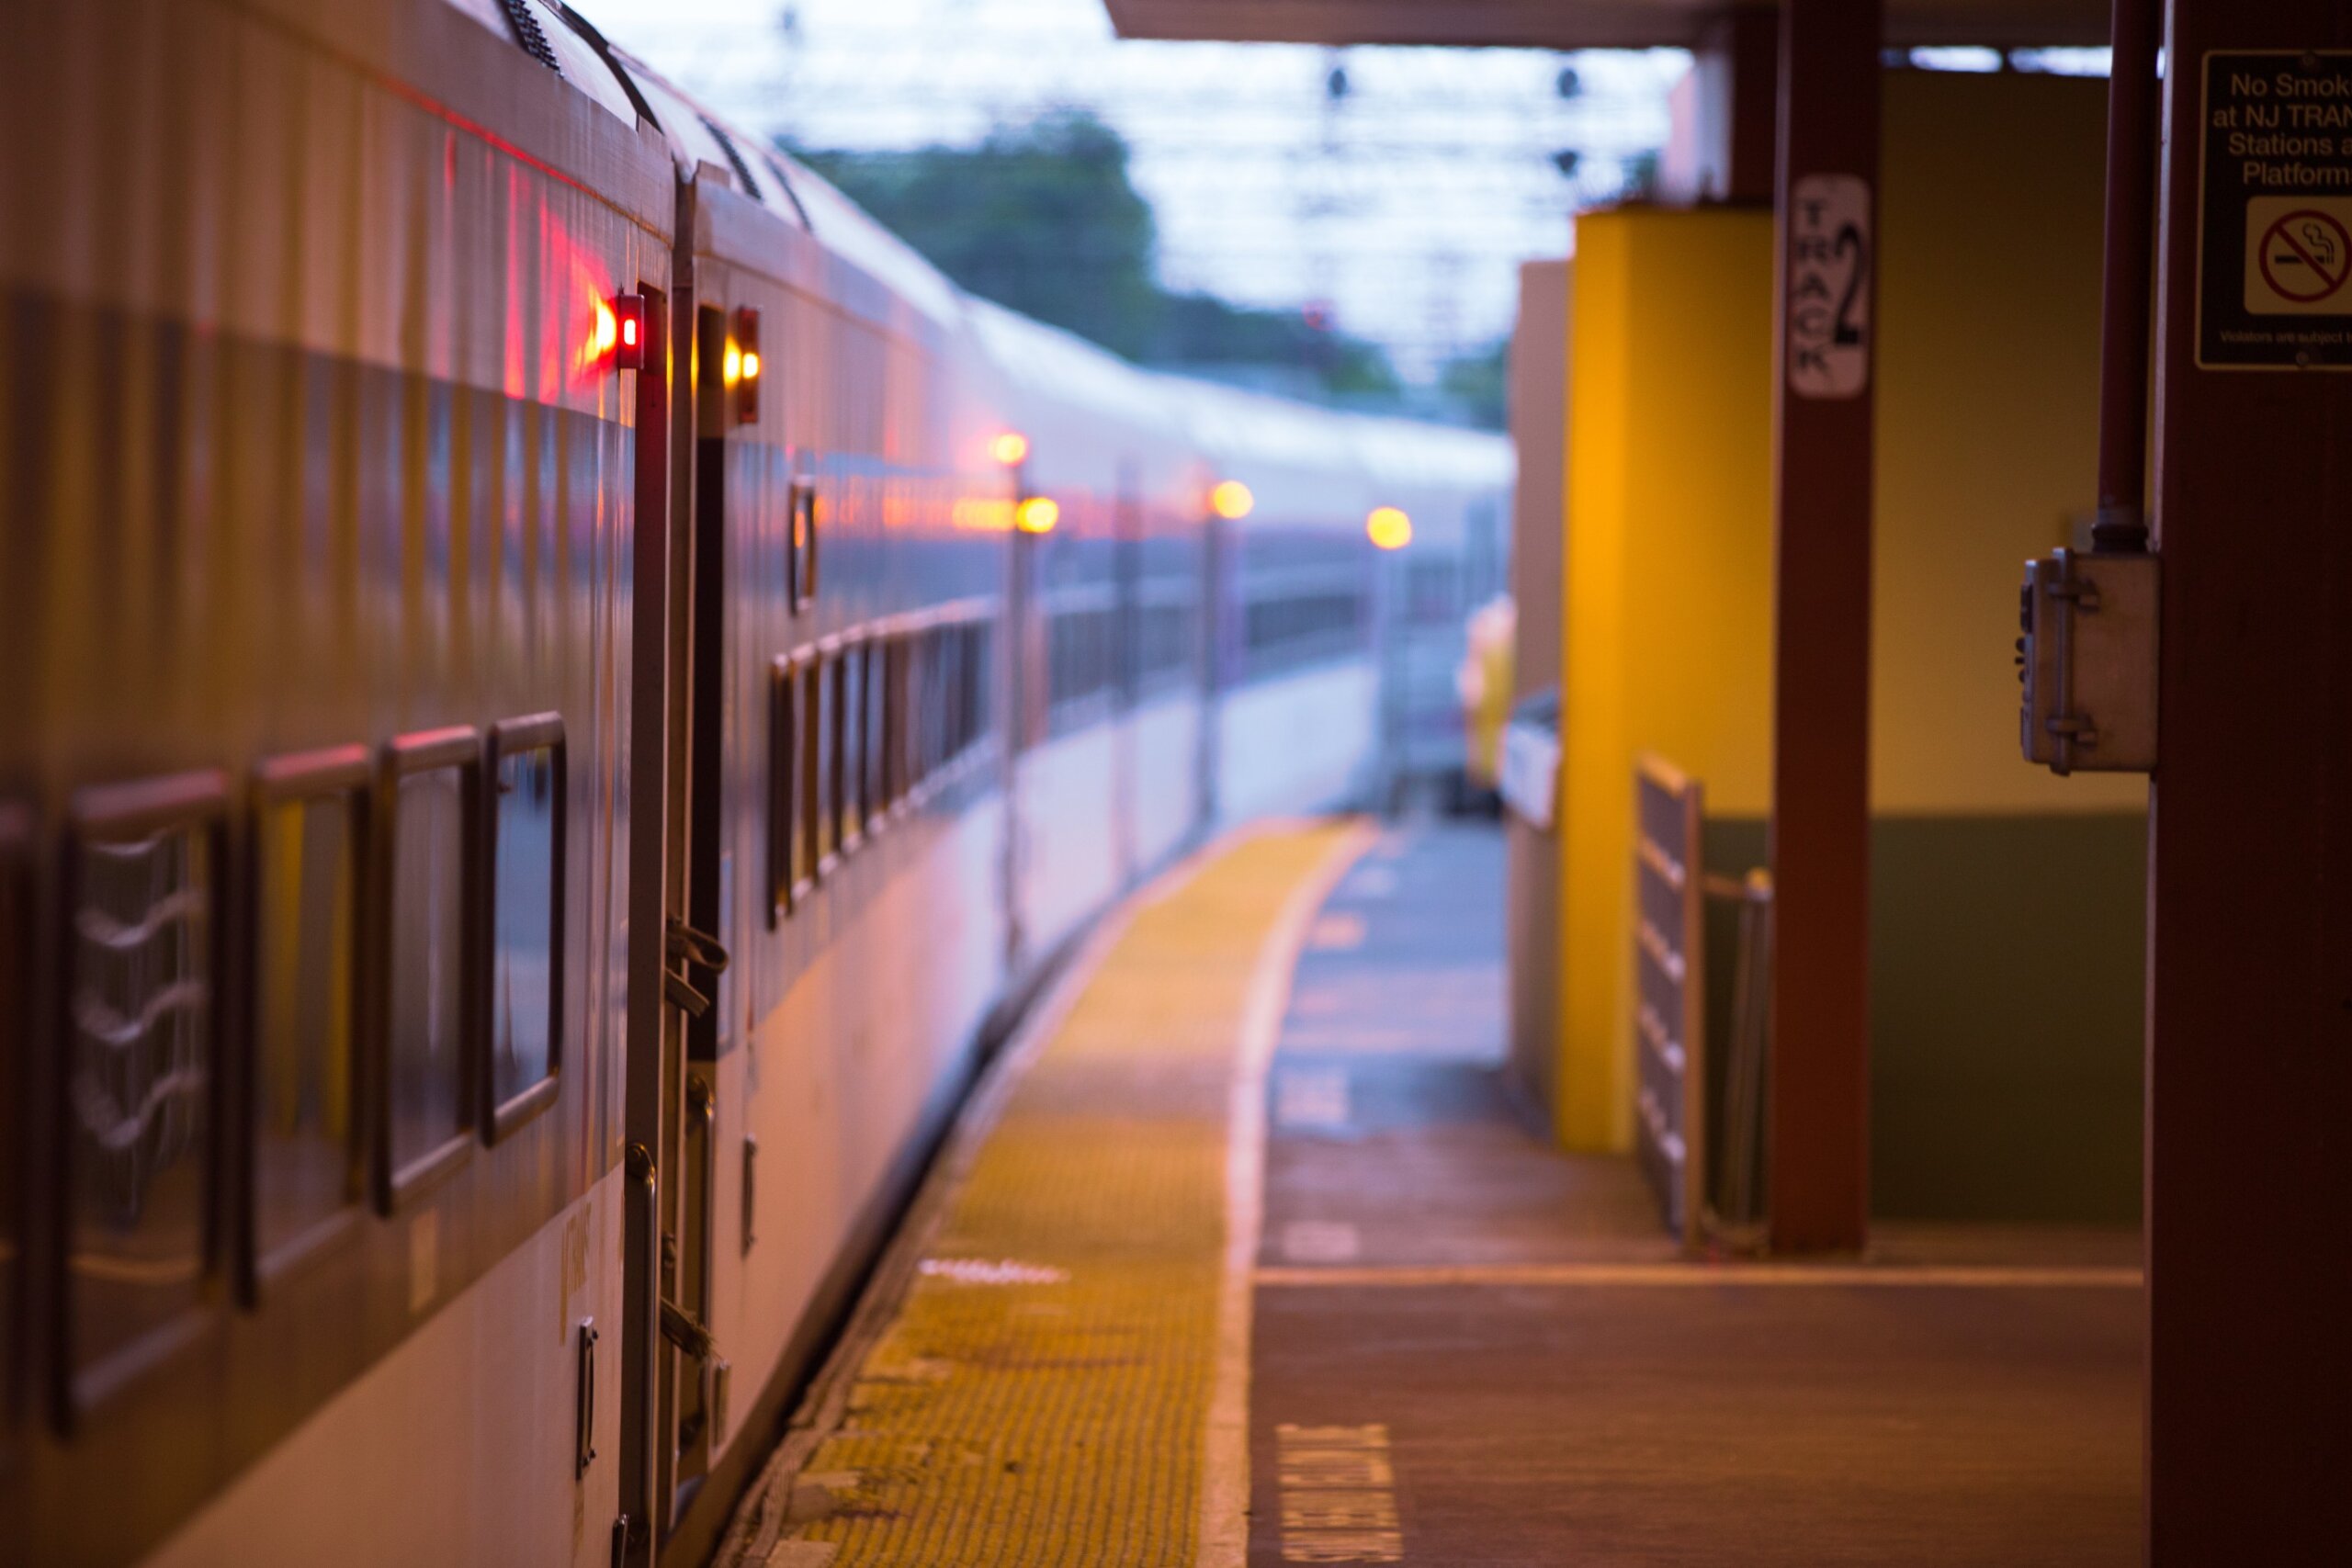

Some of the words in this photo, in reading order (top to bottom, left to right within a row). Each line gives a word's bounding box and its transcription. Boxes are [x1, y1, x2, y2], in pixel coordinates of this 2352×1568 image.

[2231, 73, 2267, 96] No
[2275, 73, 2352, 96] Smok
[2212, 104, 2237, 128] at
[2245, 104, 2280, 128] NJ
[2228, 131, 2334, 156] Stations
[2243, 161, 2352, 186] Platform
[1795, 198, 1829, 376] TRACK
[1834, 220, 1863, 345] 2
